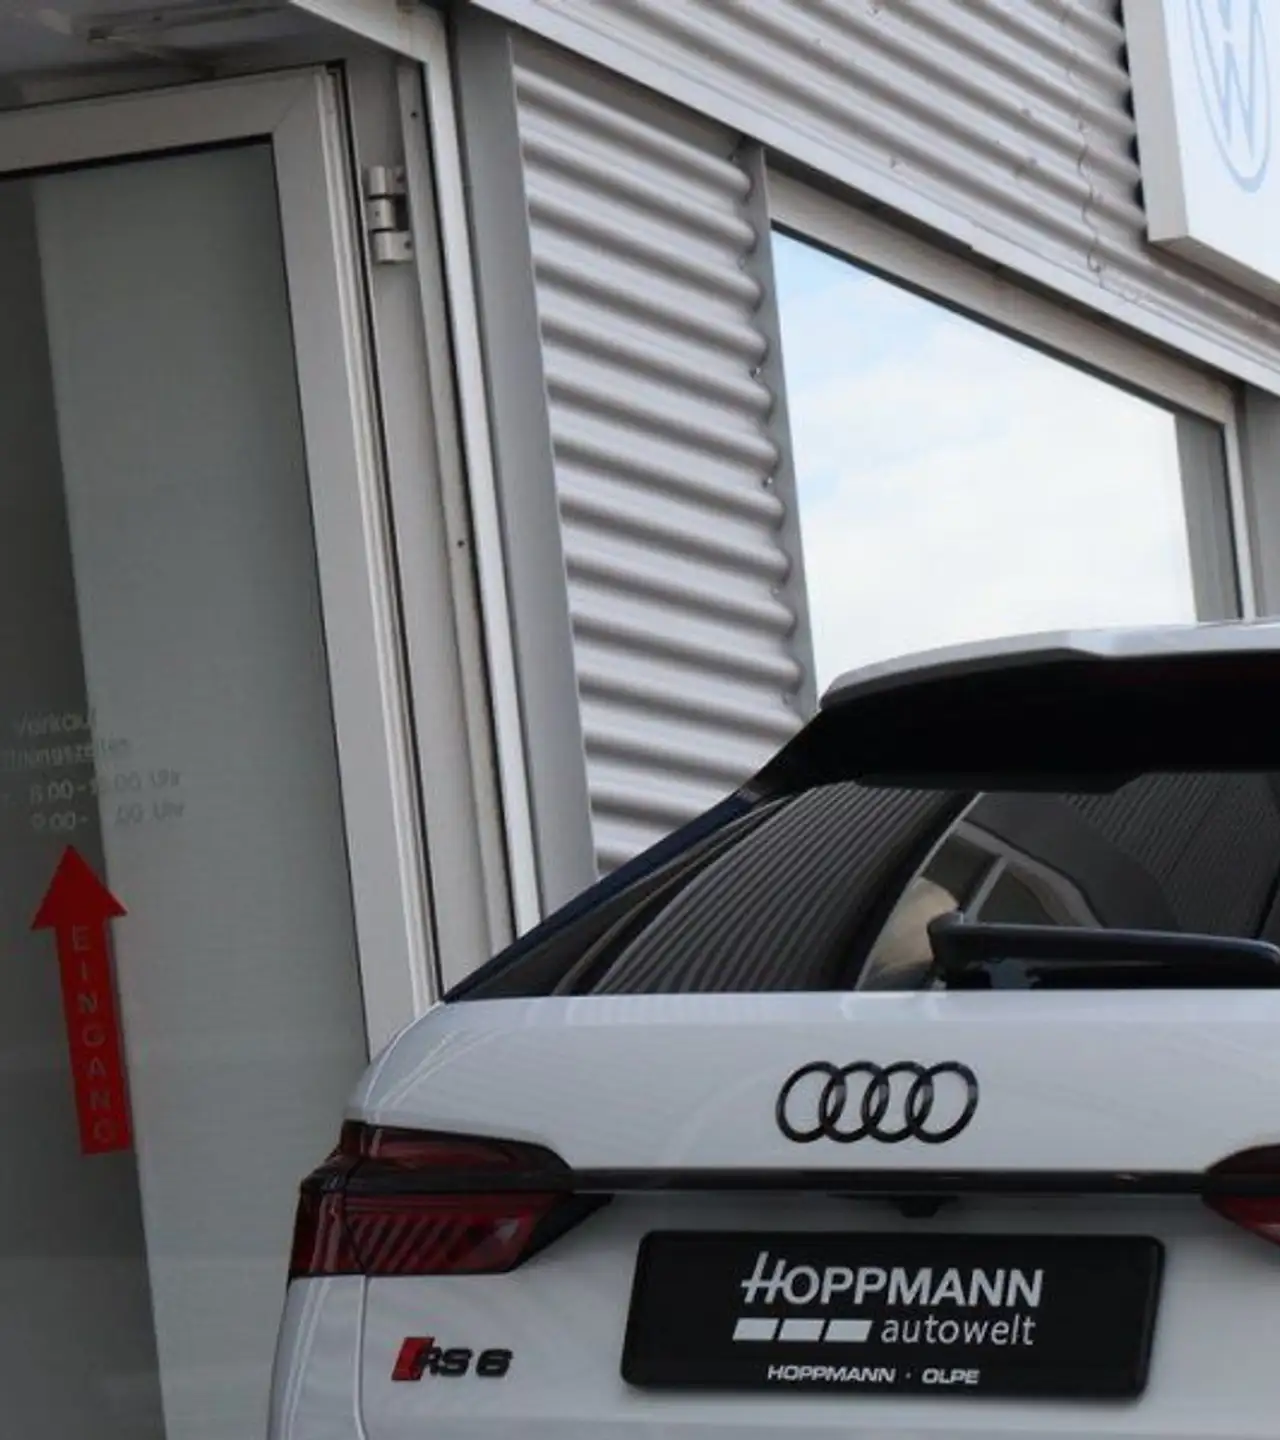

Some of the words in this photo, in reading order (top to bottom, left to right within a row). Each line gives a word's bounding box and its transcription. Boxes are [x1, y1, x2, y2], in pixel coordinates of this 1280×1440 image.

[71, 923, 118, 1146] EINGANG
[740, 1251, 1045, 1307] HOPPMANN
[880, 1312, 1037, 1346] autowelt
[767, 1364, 897, 1384] HOPPMANN
[921, 1367, 981, 1385] OLPE
